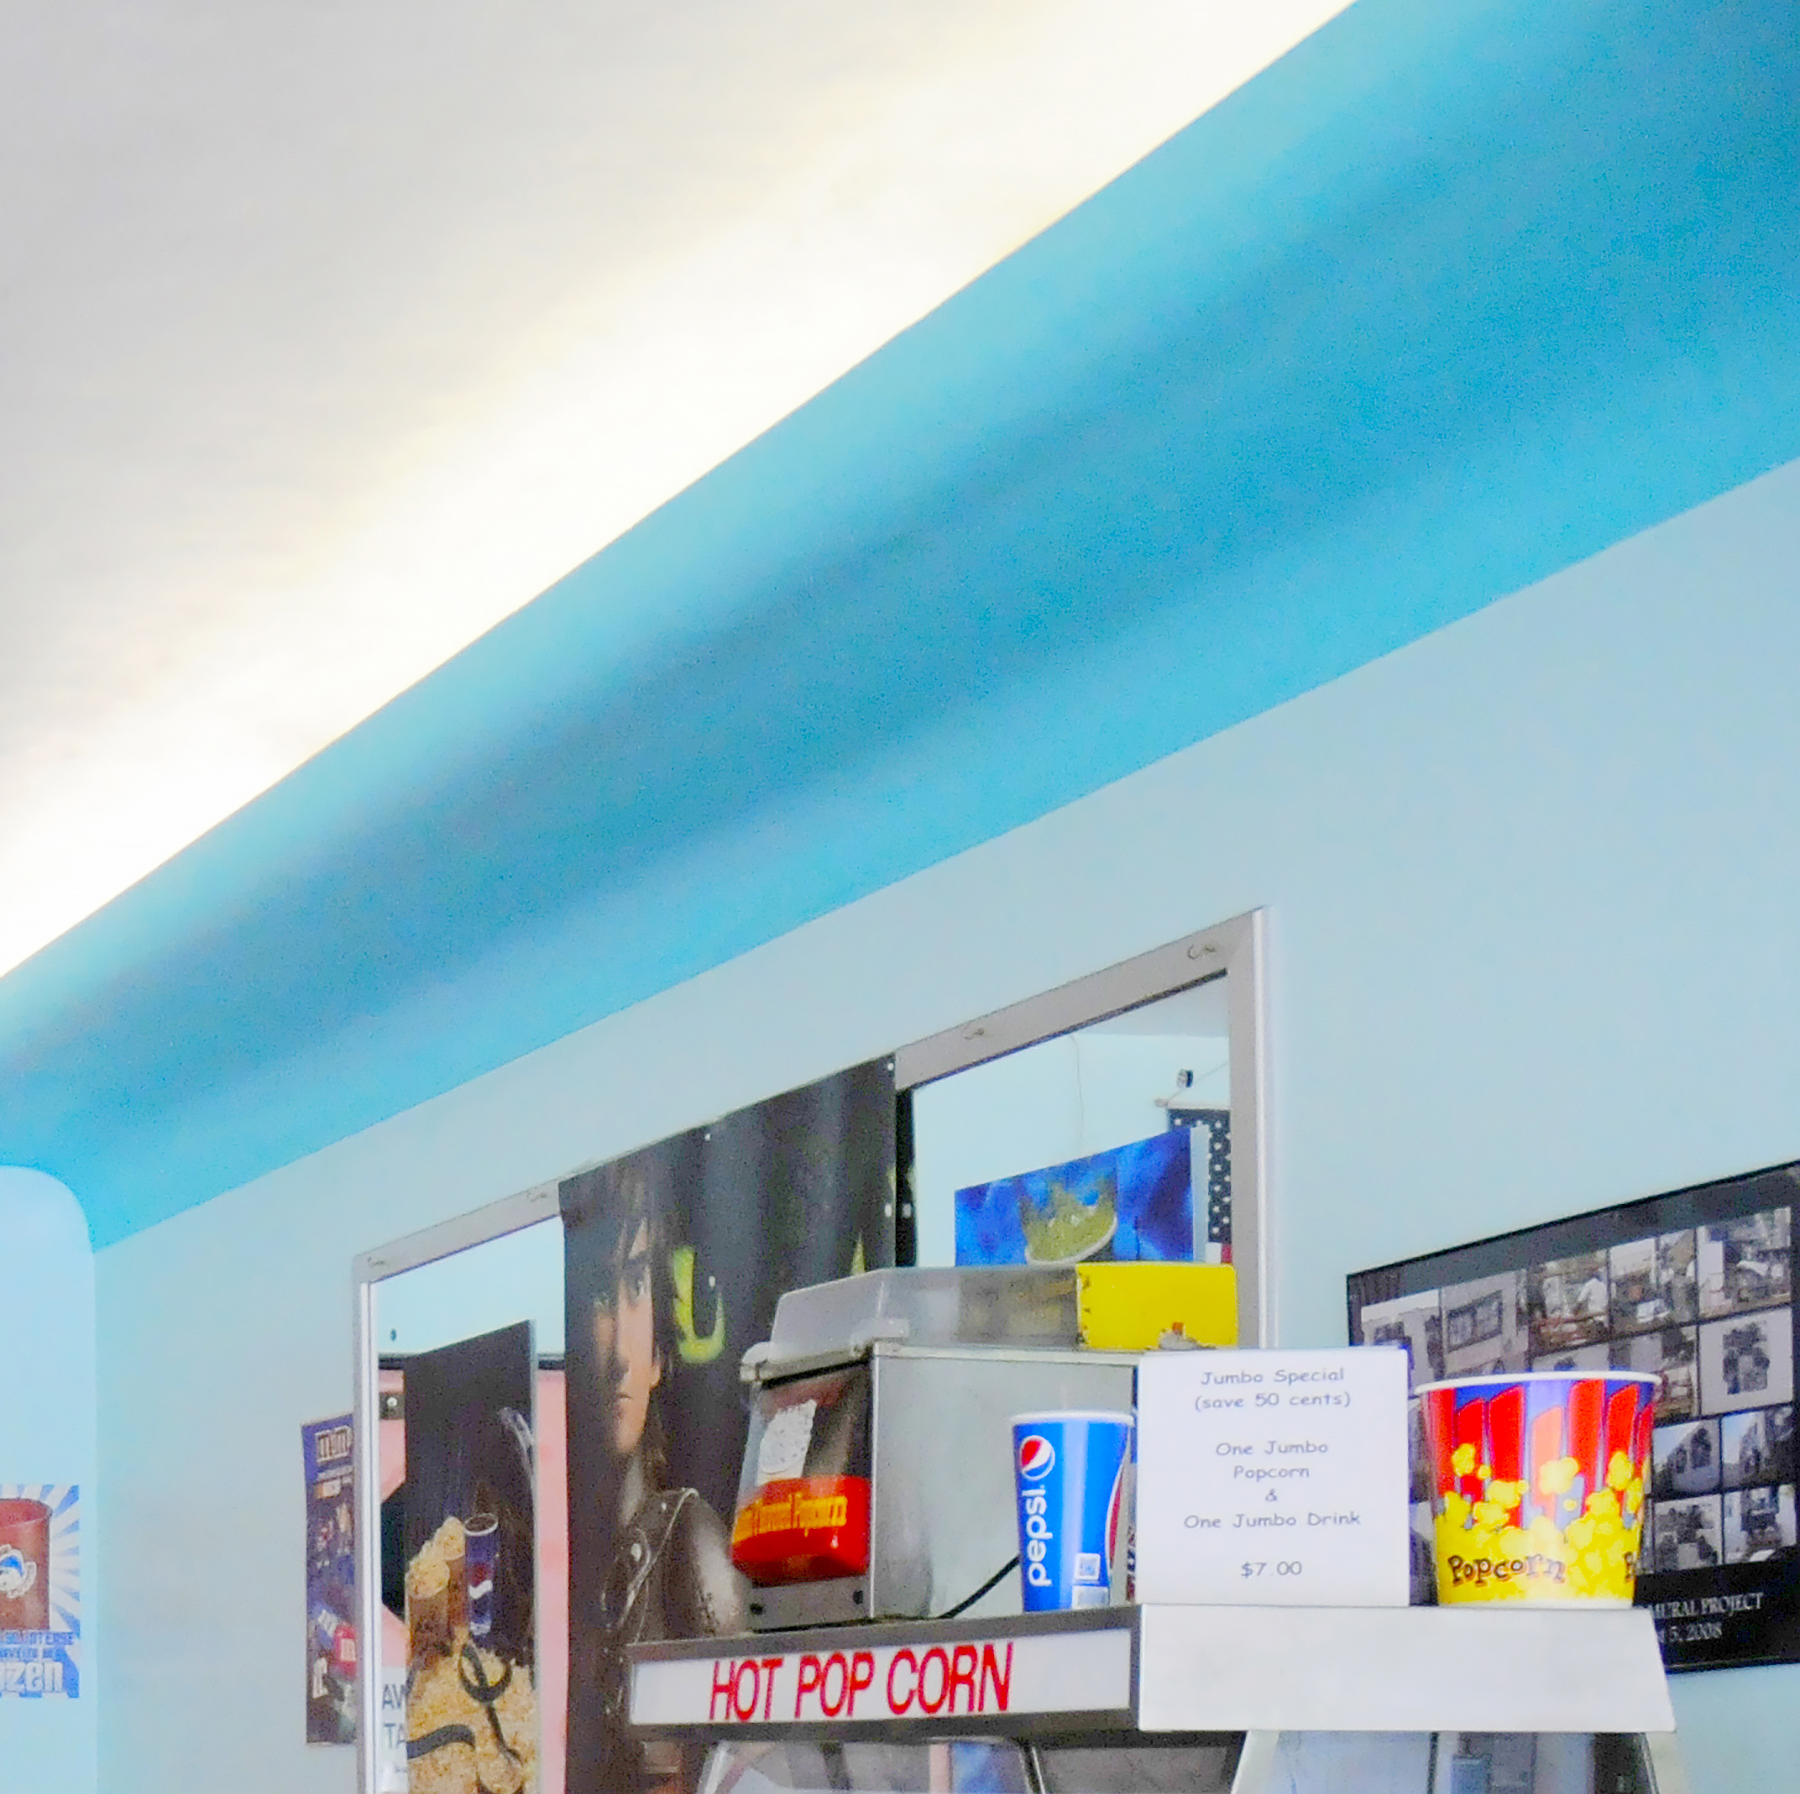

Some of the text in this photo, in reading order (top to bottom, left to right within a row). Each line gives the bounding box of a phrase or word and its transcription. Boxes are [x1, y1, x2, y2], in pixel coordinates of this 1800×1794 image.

[1200, 1367, 1345, 1388] Jumbo Special
[1194, 1391, 1352, 1413] (save 50 cents)
[1215, 1440, 1329, 1456] One Jumbo
[1234, 1465, 1311, 1483] Popcorn
[1264, 1488, 1278, 1503] &
[1183, 1510, 1362, 1529] One Jumbo Drink
[1021, 1488, 1053, 1588] pepsi
[1240, 1560, 1303, 1579] $7.00
[1447, 1553, 1566, 1588] Popcorn
[1701, 1591, 1764, 1617] PROJECT
[709, 1641, 1015, 1722] HOT POP CORN
